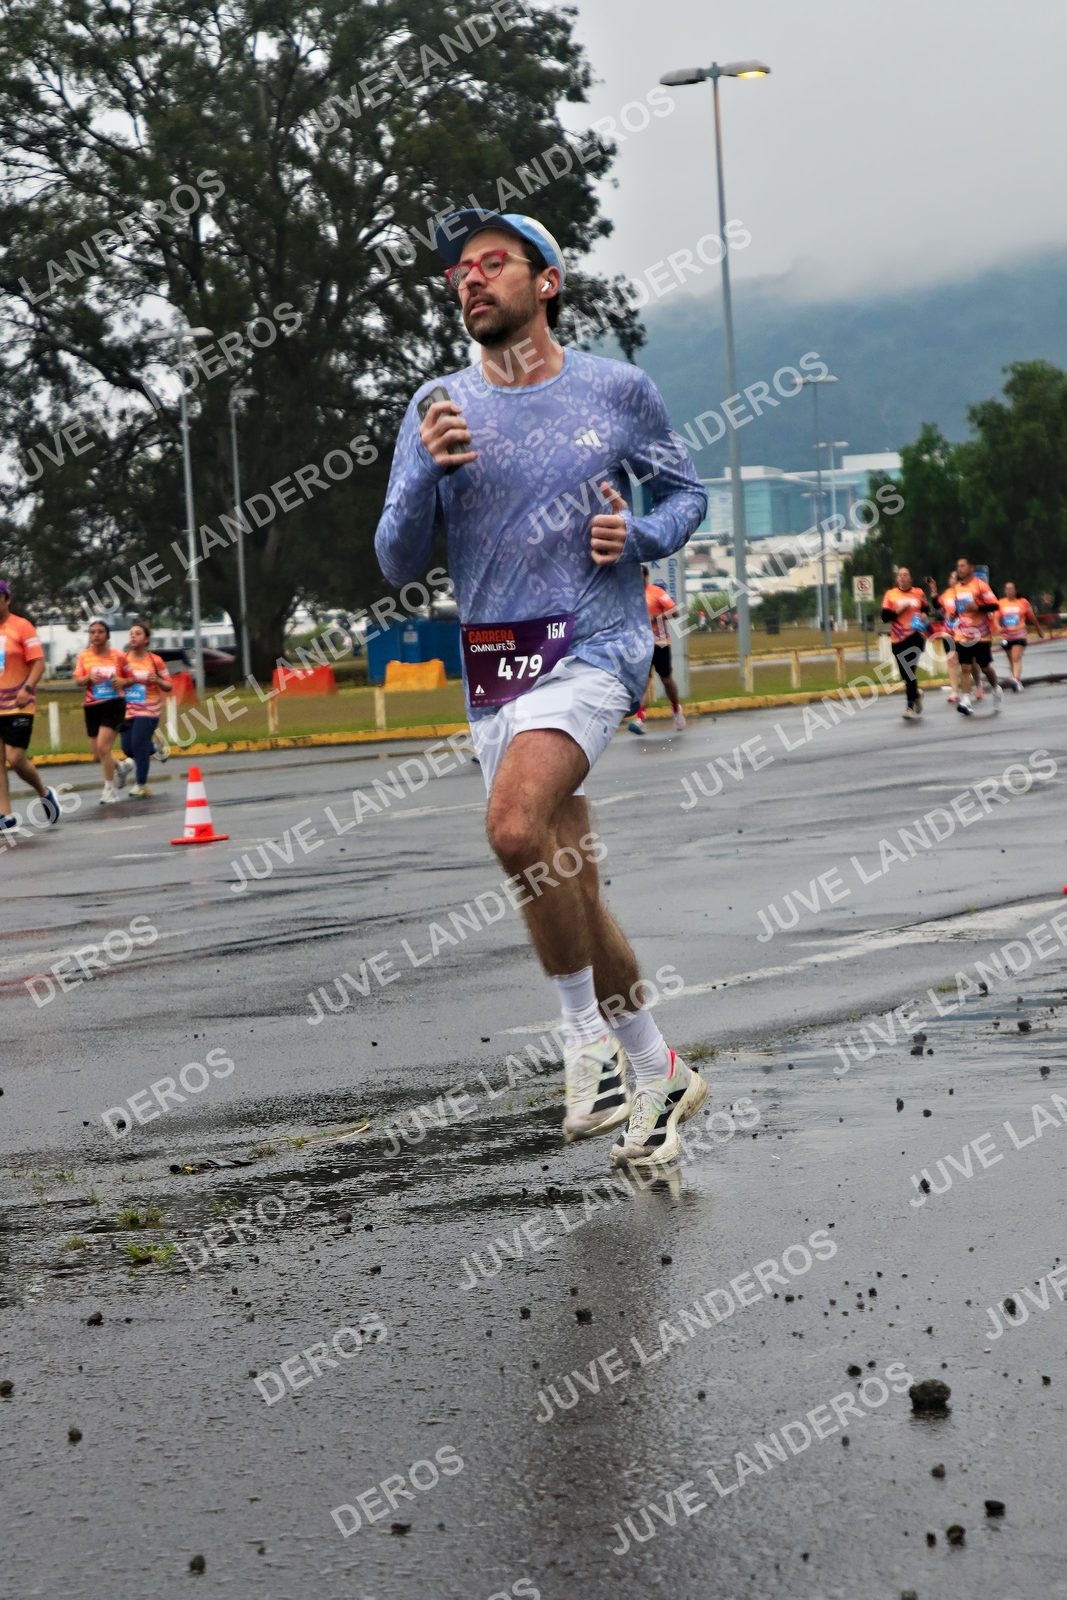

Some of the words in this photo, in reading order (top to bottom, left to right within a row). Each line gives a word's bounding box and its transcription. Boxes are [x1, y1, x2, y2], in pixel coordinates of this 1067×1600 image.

[468, 629, 514, 643] CARRERA
[547, 622, 567, 639] 15K
[498, 654, 543, 680] 479
